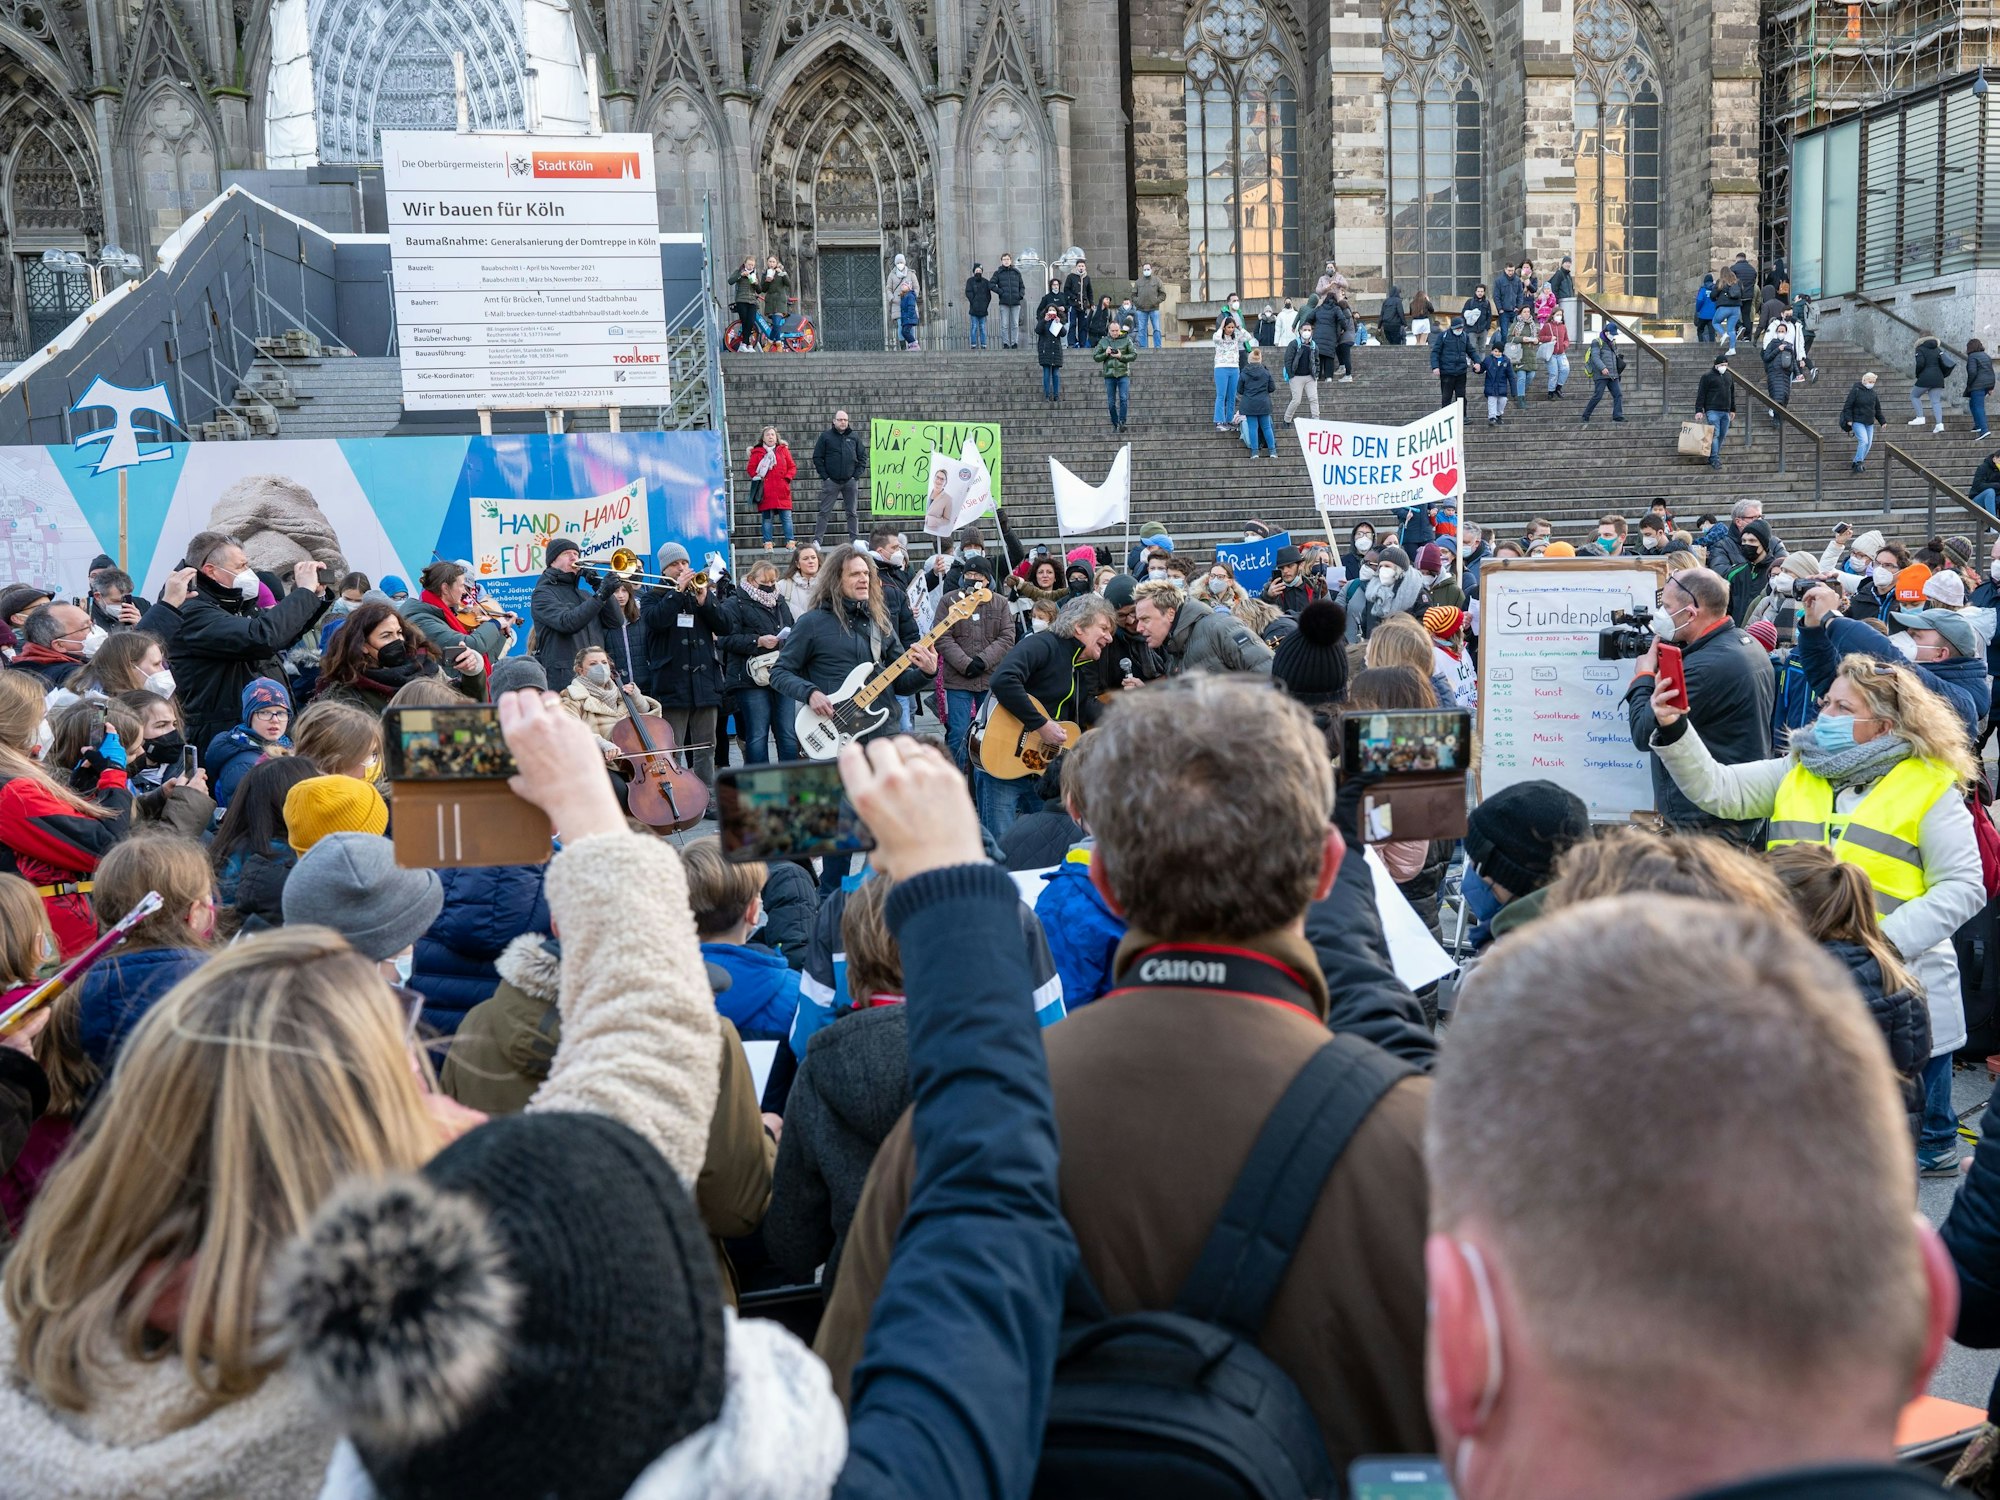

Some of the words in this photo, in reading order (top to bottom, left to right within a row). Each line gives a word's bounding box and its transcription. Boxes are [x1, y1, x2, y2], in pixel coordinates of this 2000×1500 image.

[402, 160, 416, 168] Die
[417, 160, 504, 170] Oberbürgermeisterin
[538, 160, 567, 171] Stadt
[568, 159, 594, 171] Köln
[402, 202, 436, 216] Wir
[440, 201, 493, 216] bauen
[497, 202, 522, 216] für
[526, 201, 564, 216] Köln
[406, 236, 488, 246] Baumaßnahme:
[490, 238, 564, 248] Generalsanierung
[565, 238, 578, 246] der
[580, 238, 627, 248] Domtreppe
[628, 238, 636, 246] in
[638, 238, 656, 246] Köln
[526, 264, 540, 272] April
[512, 296, 544, 304] Brücken,
[1308, 430, 1342, 456] FÜR
[1352, 436, 1388, 458] DEN
[1396, 416, 1455, 458] ERHALT
[877, 456, 906, 476] und
[1323, 464, 1402, 485] UNSERER
[500, 512, 560, 534] HAND
[565, 520, 581, 533] in
[583, 496, 630, 532] HAND
[501, 544, 542, 574] FÜR
[1228, 547, 1272, 571] Rettet
[1900, 590, 1920, 599] HELL
[1493, 670, 1508, 678] Zeit
[1535, 670, 1552, 678] Fach
[1534, 687, 1563, 697] Kunst
[1533, 710, 1580, 720] Sozialkunde
[1592, 711, 1614, 721] MSS
[1533, 733, 1564, 742] Musik
[1587, 732, 1632, 744] Singeklasse
[1532, 757, 1565, 768] Musik
[1584, 758, 1633, 769] Singeklasse
[1636, 759, 1643, 769] 6
[1139, 958, 1226, 984] Canon
